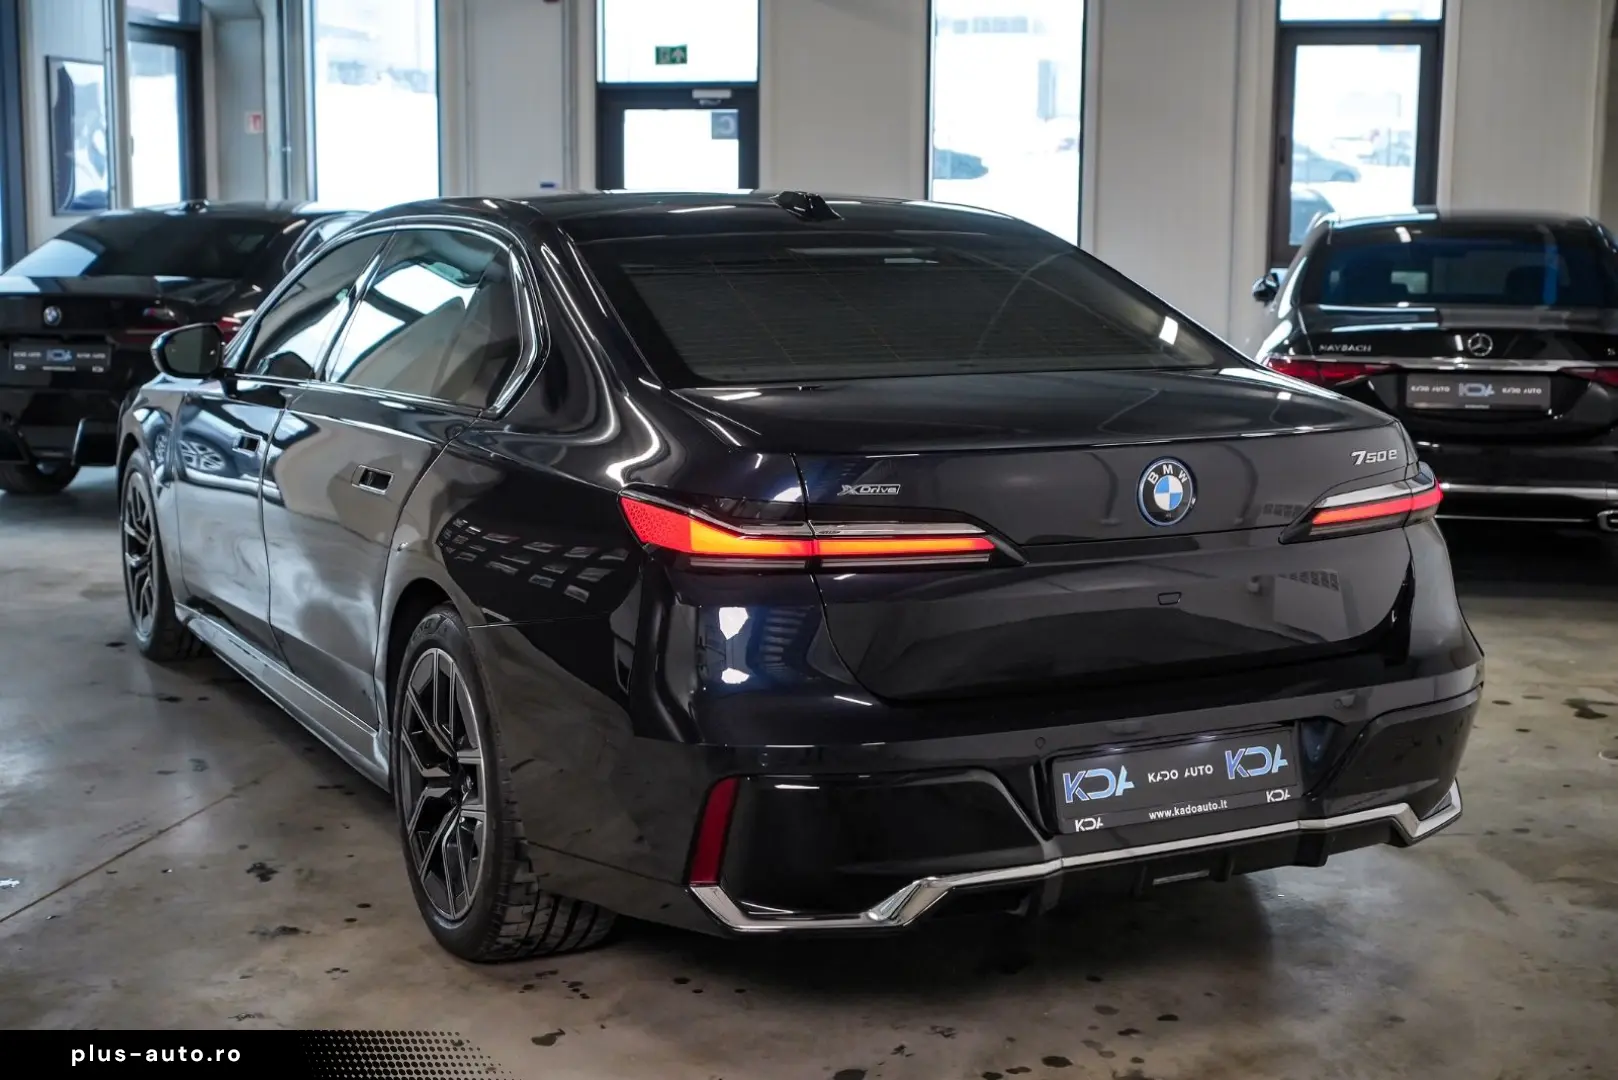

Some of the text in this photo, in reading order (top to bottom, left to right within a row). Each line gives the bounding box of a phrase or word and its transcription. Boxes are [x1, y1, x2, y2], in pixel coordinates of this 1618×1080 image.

[1351, 449, 1398, 466] 750e
[1147, 463, 1188, 485] BMW
[1062, 743, 1289, 803] KDA KADO AUTO KDA
[1265, 788, 1291, 803] KDA
[1148, 799, 1229, 820] www.kadoauto.lt
[1074, 816, 1104, 833] KDA
